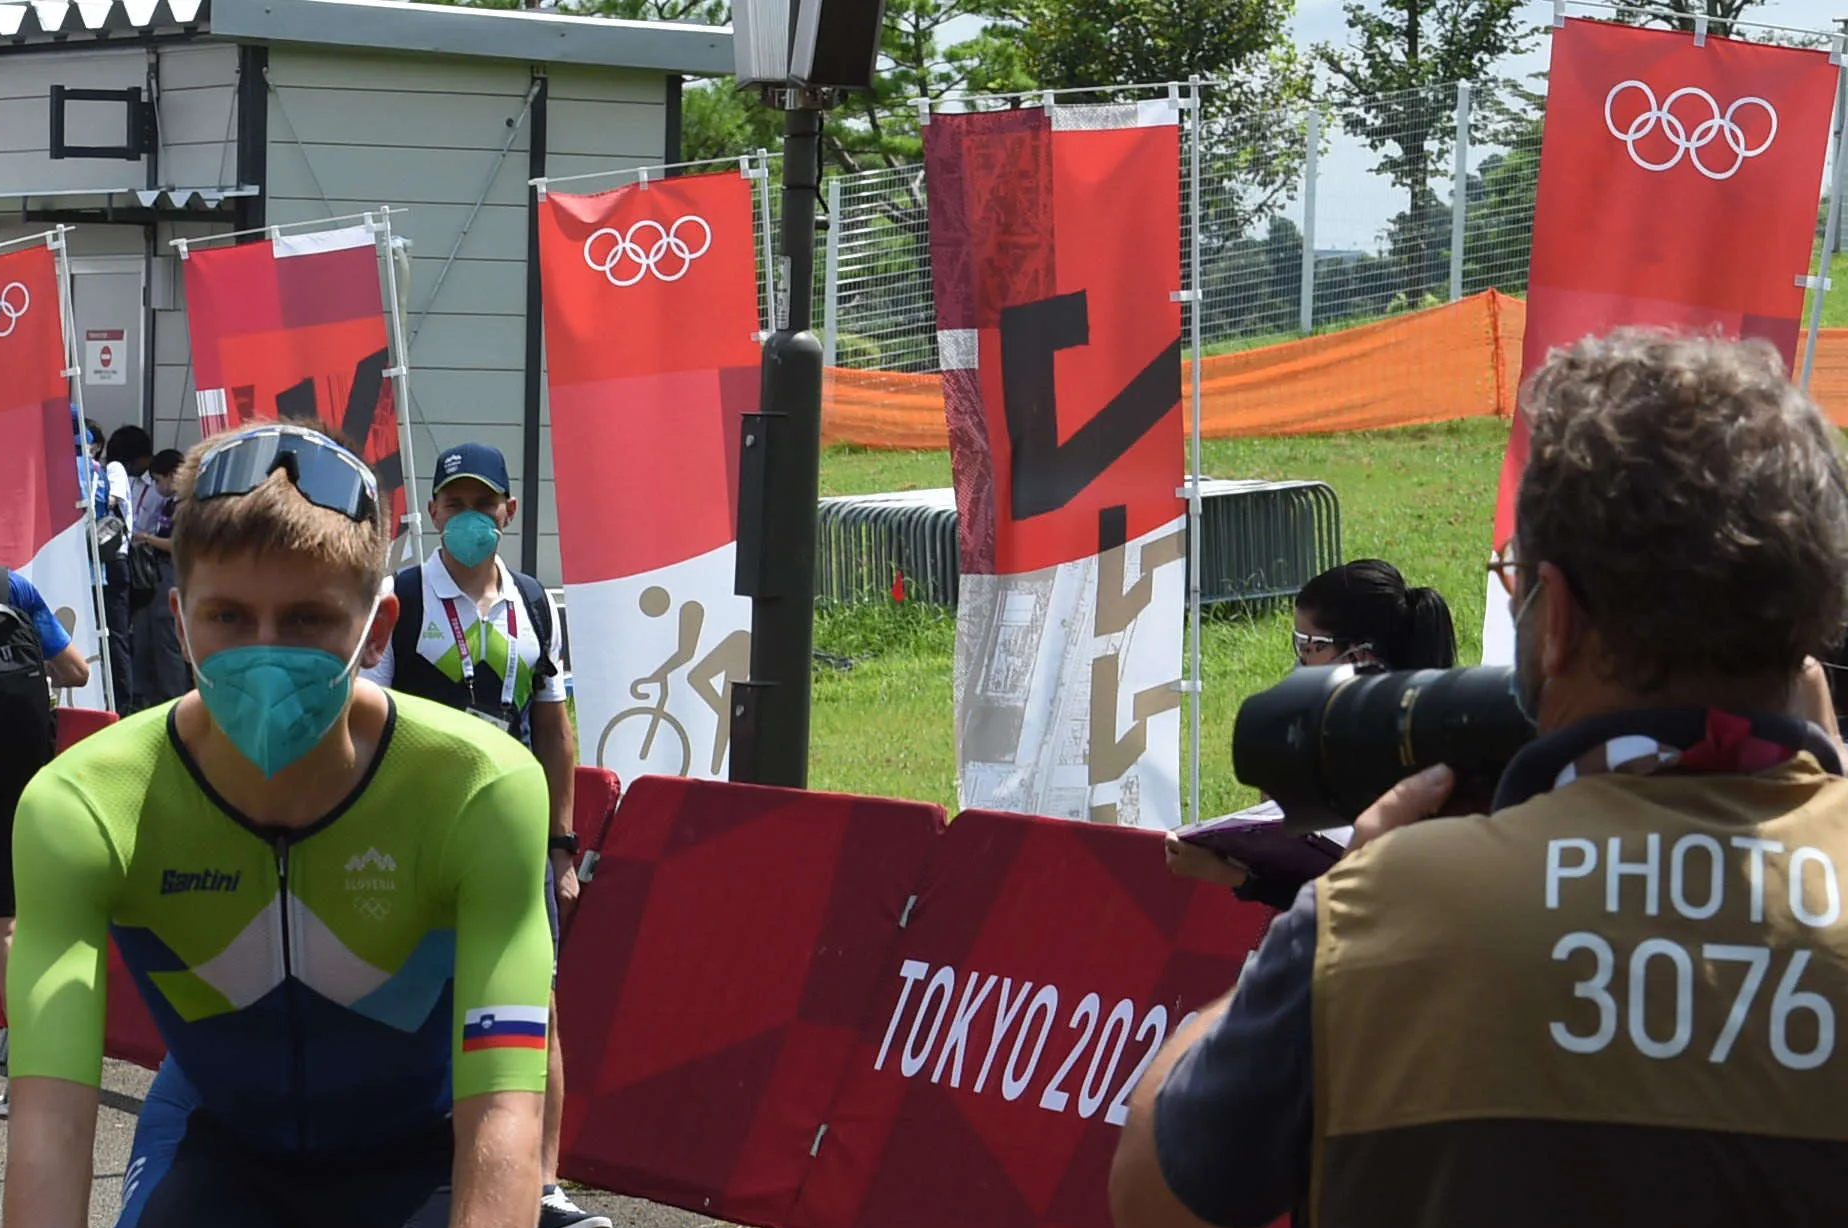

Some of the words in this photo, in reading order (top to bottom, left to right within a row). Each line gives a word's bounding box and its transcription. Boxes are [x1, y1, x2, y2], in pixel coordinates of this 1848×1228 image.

[160, 869, 242, 895] Santini
[1545, 832, 1841, 928] PHOTO
[874, 959, 1059, 1101] TOKYO
[1549, 931, 1835, 1070] 3076
